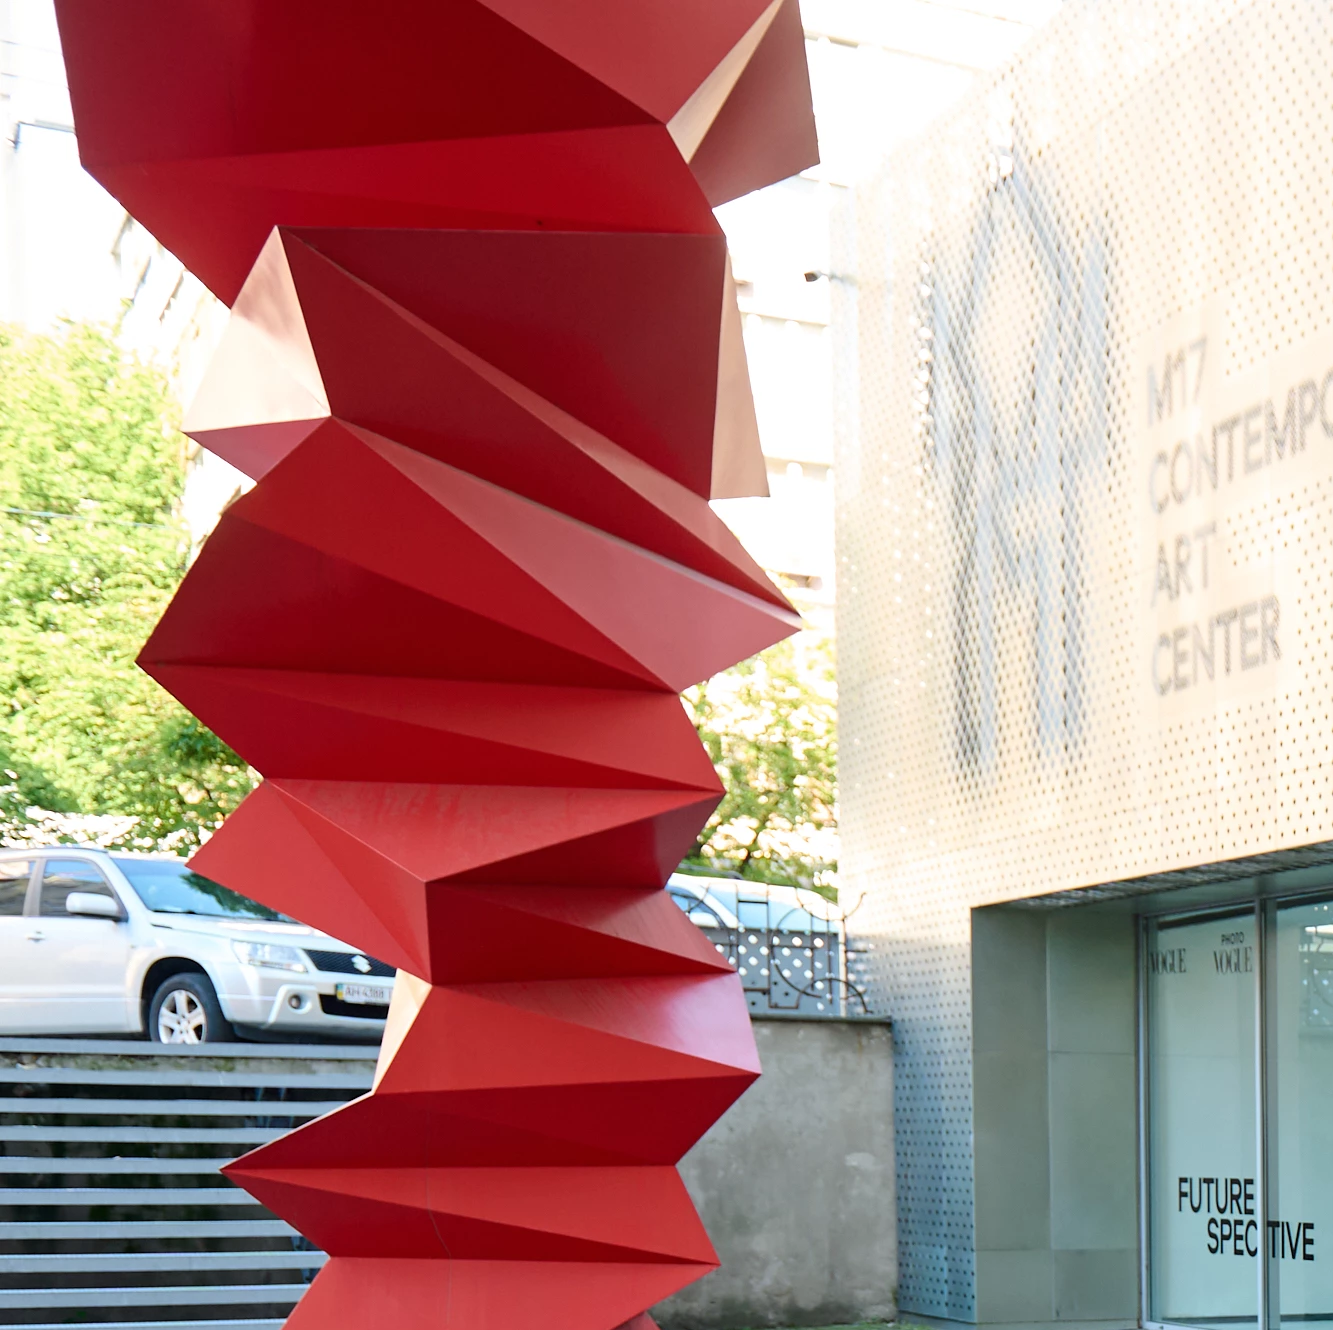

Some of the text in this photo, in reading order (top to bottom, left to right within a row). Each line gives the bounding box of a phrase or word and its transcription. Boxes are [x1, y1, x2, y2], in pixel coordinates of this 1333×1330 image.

[1146, 337, 1209, 429] M17
[1152, 522, 1217, 609] ART
[1151, 595, 1282, 697] CENTER
[1221, 931, 1245, 945] PHOTO
[1150, 948, 1187, 975] VOGUE
[1213, 946, 1253, 975] VOGUE
[1178, 1176, 1255, 1215] FUTURE
